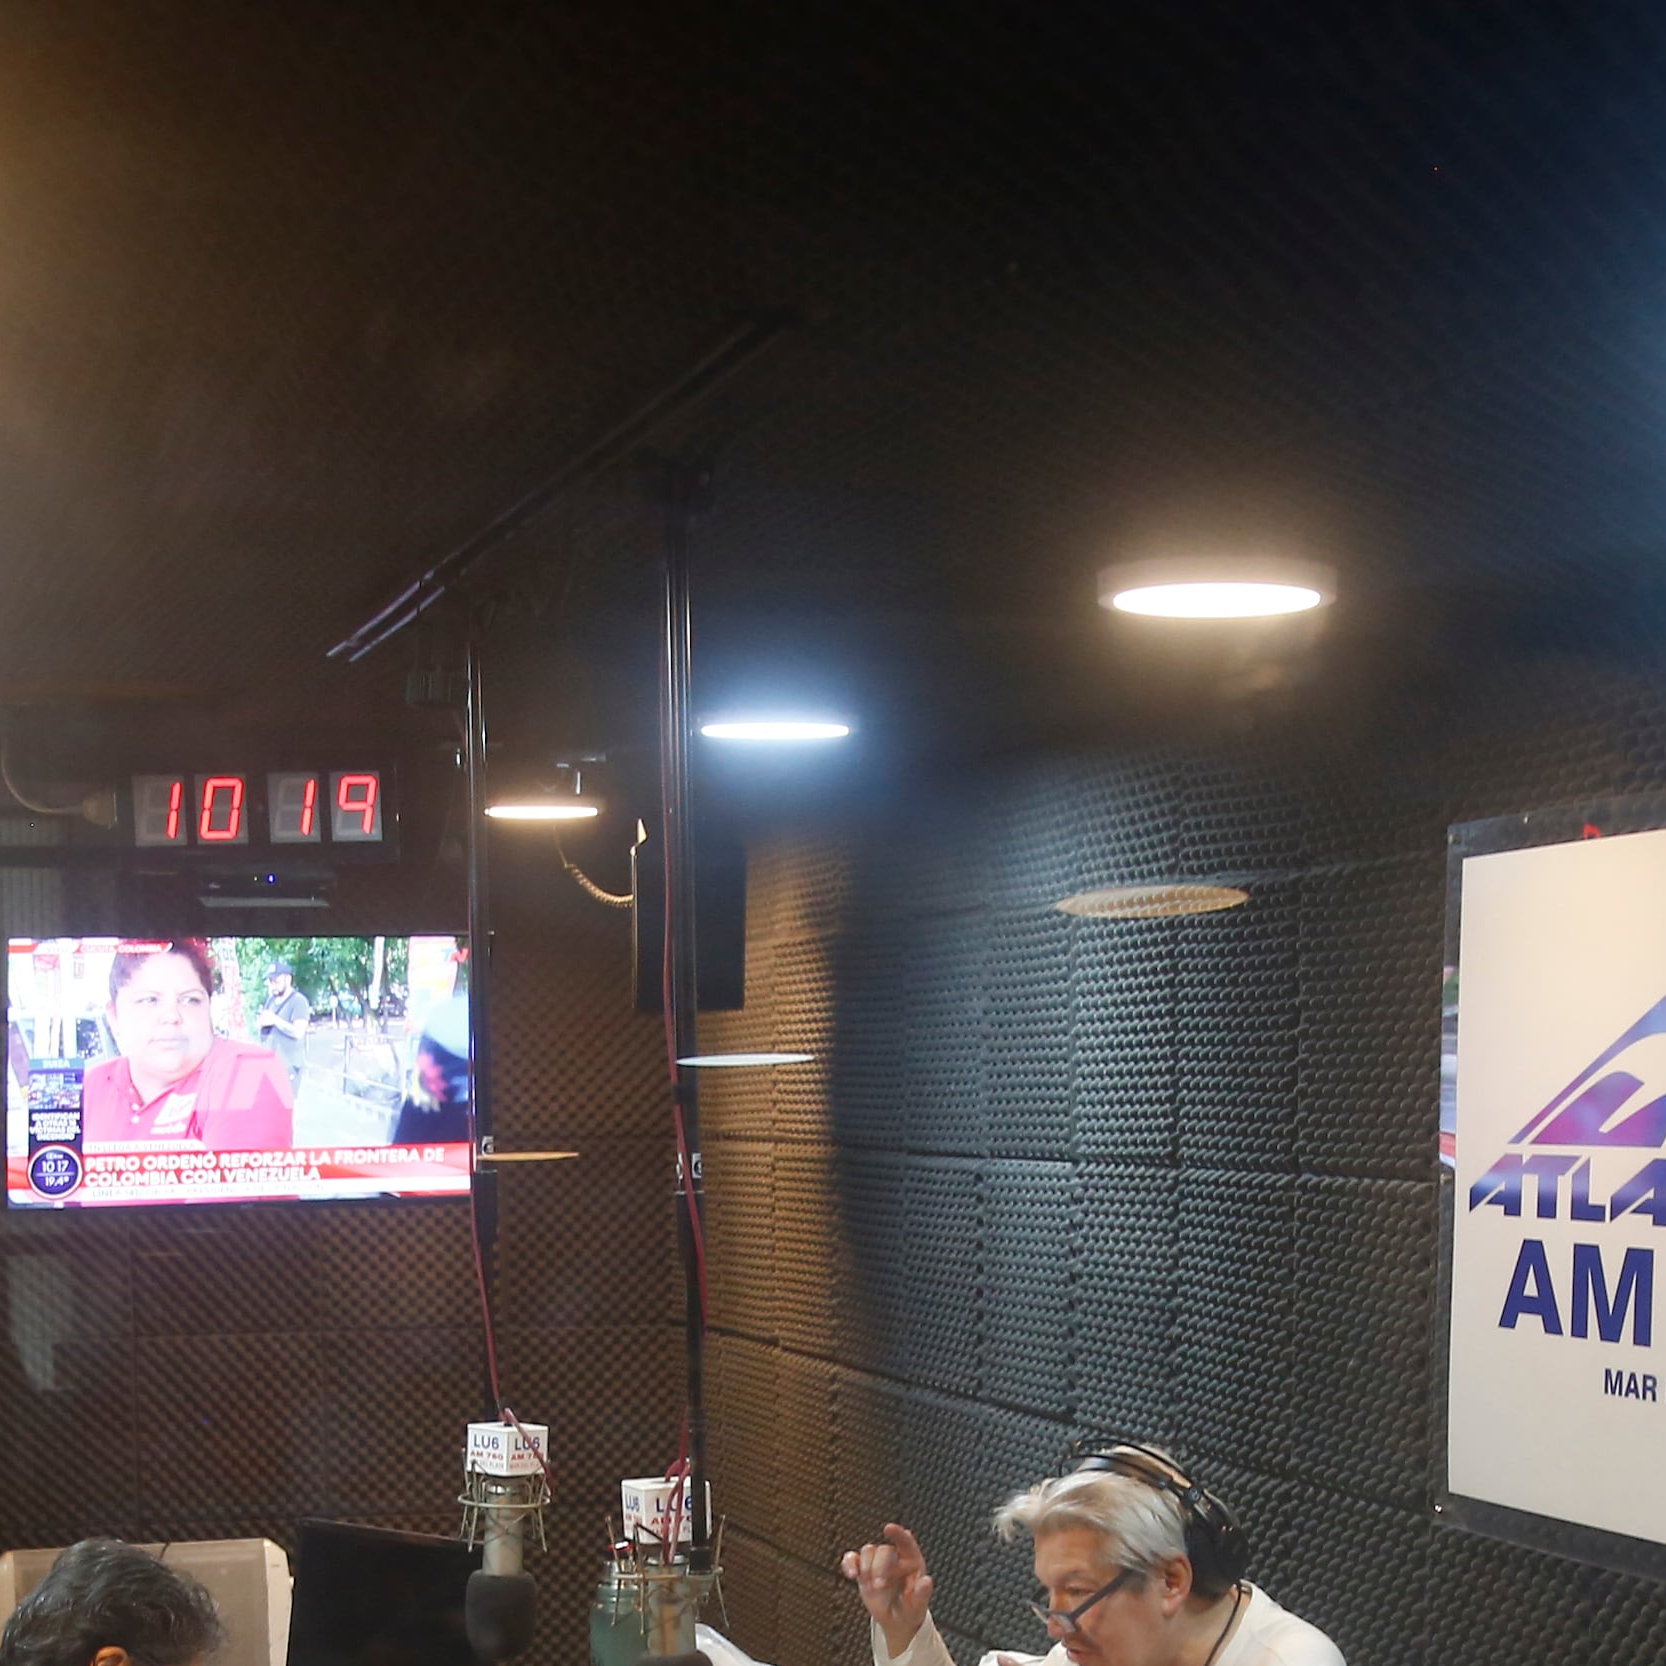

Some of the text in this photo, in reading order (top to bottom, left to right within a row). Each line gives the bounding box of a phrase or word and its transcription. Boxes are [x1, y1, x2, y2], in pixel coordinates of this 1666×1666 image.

[166, 774, 378, 840] 10 19
[85, 1147, 445, 1172] PETRO ORDENÓ REFORZAR LA FRONTERA DE
[84, 1166, 322, 1188] COLOMBIA CON VENEZUELA
[1498, 1238, 1654, 1347] AM
[1603, 1368, 1657, 1403] MAR
[473, 1434, 500, 1450] LU6
[470, 1449, 504, 1460] AM 760
[625, 1492, 640, 1512] LU6
